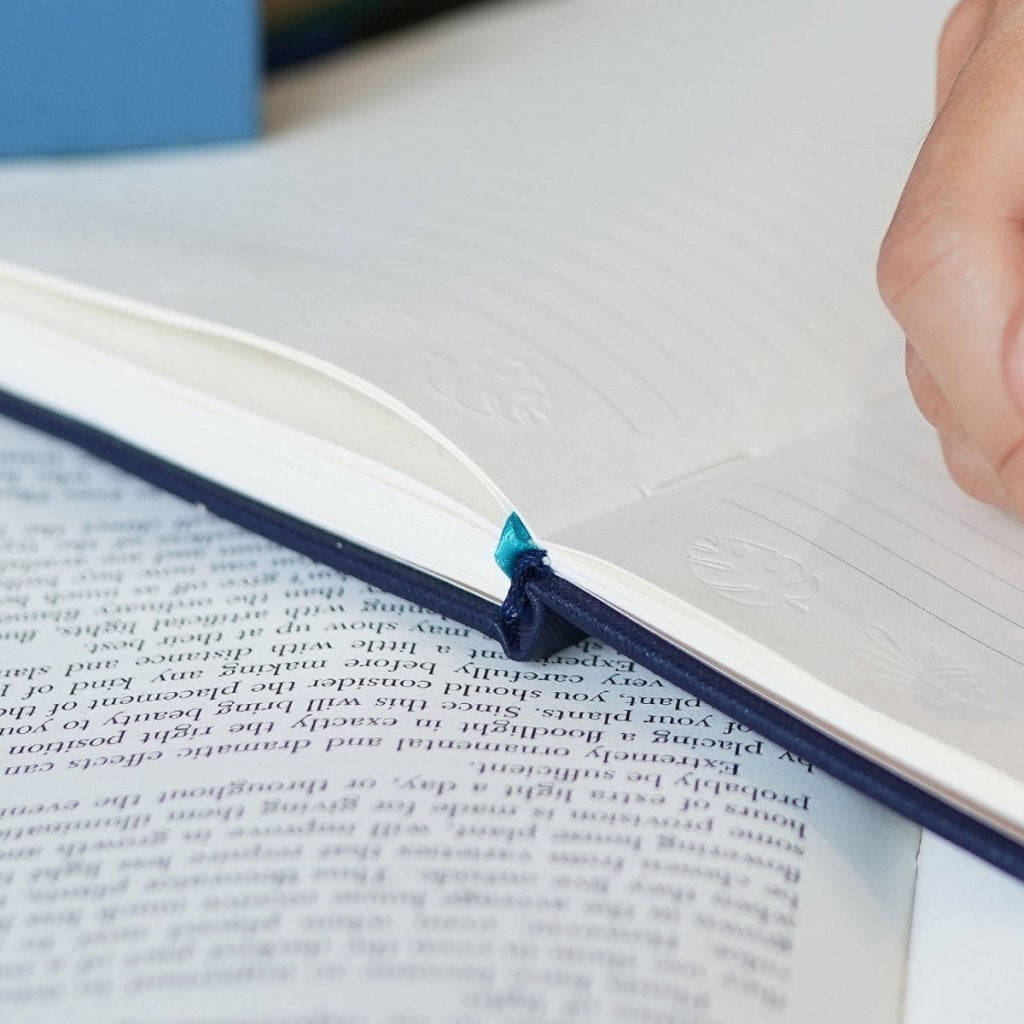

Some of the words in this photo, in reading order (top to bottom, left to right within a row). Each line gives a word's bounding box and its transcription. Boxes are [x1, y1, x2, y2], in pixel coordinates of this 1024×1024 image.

[224, 591, 269, 607] the
[283, 604, 345, 619] with
[54, 620, 136, 639] lights,
[151, 609, 269, 633] artificial
[274, 621, 311, 636] up
[323, 621, 399, 636] show
[156, 631, 222, 647] their
[236, 627, 263, 641] at
[408, 622, 469, 639] may
[83, 638, 145, 654] best.
[270, 640, 333, 657] with
[350, 639, 417, 656] little
[436, 644, 451, 655] a
[134, 646, 253, 668] distance
[344, 657, 437, 675] before
[467, 647, 636, 673] Experient
[64, 659, 119, 678] and
[150, 668, 203, 684] any
[218, 659, 327, 679] making
[453, 661, 584, 686] carefully
[69, 676, 133, 696] kind
[251, 680, 296, 696] the
[307, 676, 432, 692] consider
[601, 673, 664, 689] very
[21, 684, 54, 701] of
[86, 680, 242, 712] placement
[443, 681, 542, 702] should
[553, 687, 607, 704] you
[45, 701, 78, 718] of
[213, 699, 293, 717] bring
[306, 697, 360, 713] will
[375, 697, 427, 713] this
[441, 701, 521, 719] Since
[619, 693, 702, 710] plant,
[101, 706, 203, 728] beauty
[290, 714, 398, 733] exactly
[534, 707, 633, 725] plants.
[643, 713, 713, 729] your
[62, 719, 90, 732] to
[139, 723, 214, 746] right
[229, 721, 275, 737] the
[415, 719, 442, 734] in
[458, 719, 602, 744] floodlight
[722, 721, 752, 735] of
[8, 729, 127, 757] position
[325, 737, 383, 753] and
[620, 731, 636, 743] a
[652, 730, 764, 757] placing
[177, 738, 312, 760] dramatic
[396, 737, 571, 758] ornamental
[3, 761, 55, 776] can
[67, 750, 163, 771] effects
[585, 745, 742, 776] Extremely
[469, 761, 614, 784] sufficient.
[626, 772, 661, 789] be
[157, 778, 329, 805] throughout
[344, 778, 377, 791] or
[392, 775, 457, 796] day,
[472, 782, 488, 794] a
[505, 781, 573, 804] light
[673, 772, 811, 811] probably
[93, 793, 141, 810] the
[259, 797, 359, 817] giving
[588, 789, 666, 807] extra
[679, 797, 710, 813] of
[167, 805, 245, 822] them
[372, 802, 416, 817] for
[431, 802, 517, 820] made
[531, 808, 554, 822] is
[225, 819, 355, 838] improve
[569, 809, 714, 832] provision
[725, 804, 807, 839] hours
[370, 823, 430, 840] will
[55, 829, 170, 858] growth
[551, 831, 642, 852] house
[728, 828, 806, 857] some
[657, 835, 801, 883] flowering
